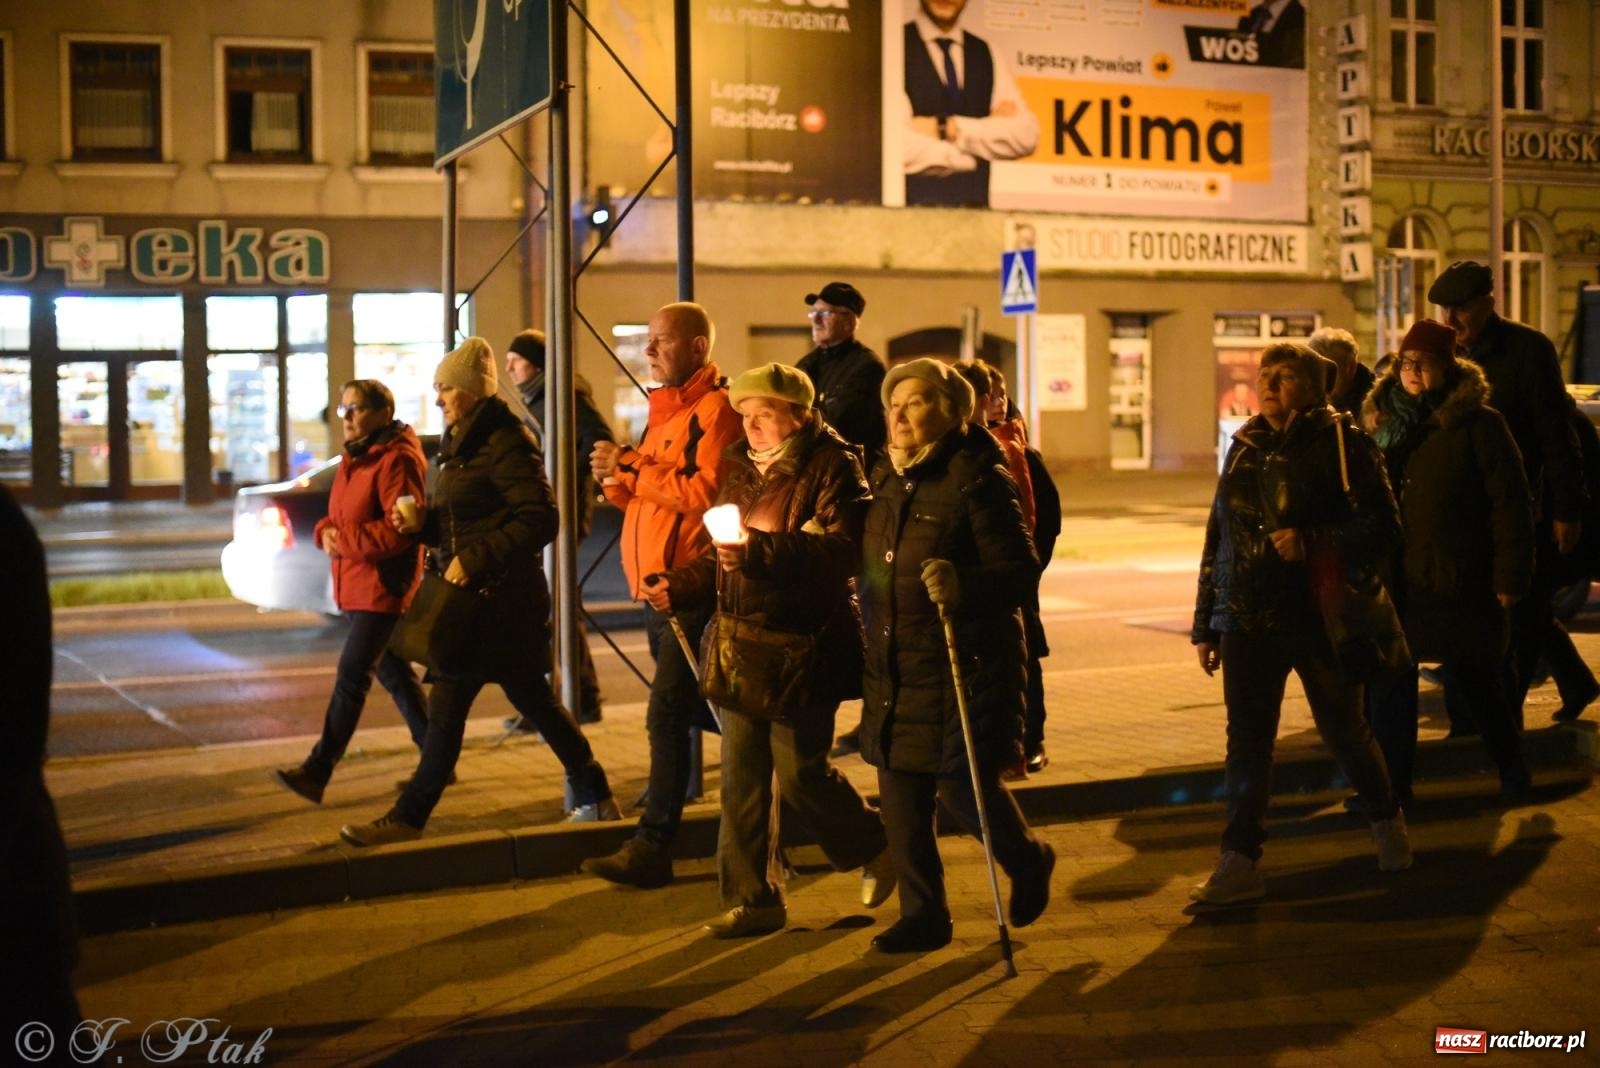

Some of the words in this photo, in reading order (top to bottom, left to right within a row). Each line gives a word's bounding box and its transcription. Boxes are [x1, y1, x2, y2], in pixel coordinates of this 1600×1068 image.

[706, 7, 733, 24] NA
[737, 9, 850, 32] PREZYDENTA
[1199, 33, 1259, 62] WOŚ
[1016, 51, 1078, 73] Lepszy
[1083, 55, 1142, 74] Powiat
[711, 79, 780, 105] Lepszy
[711, 106, 797, 131] Racibórz
[1054, 95, 1243, 166] Klima
[1433, 125, 1600, 162] RACBORSK
[1104, 173, 1112, 188] 1
[1119, 176, 1139, 190] DO
[1051, 228, 1122, 260] STUDIO
[1129, 231, 1297, 264] FOTOGRAFICZNE
